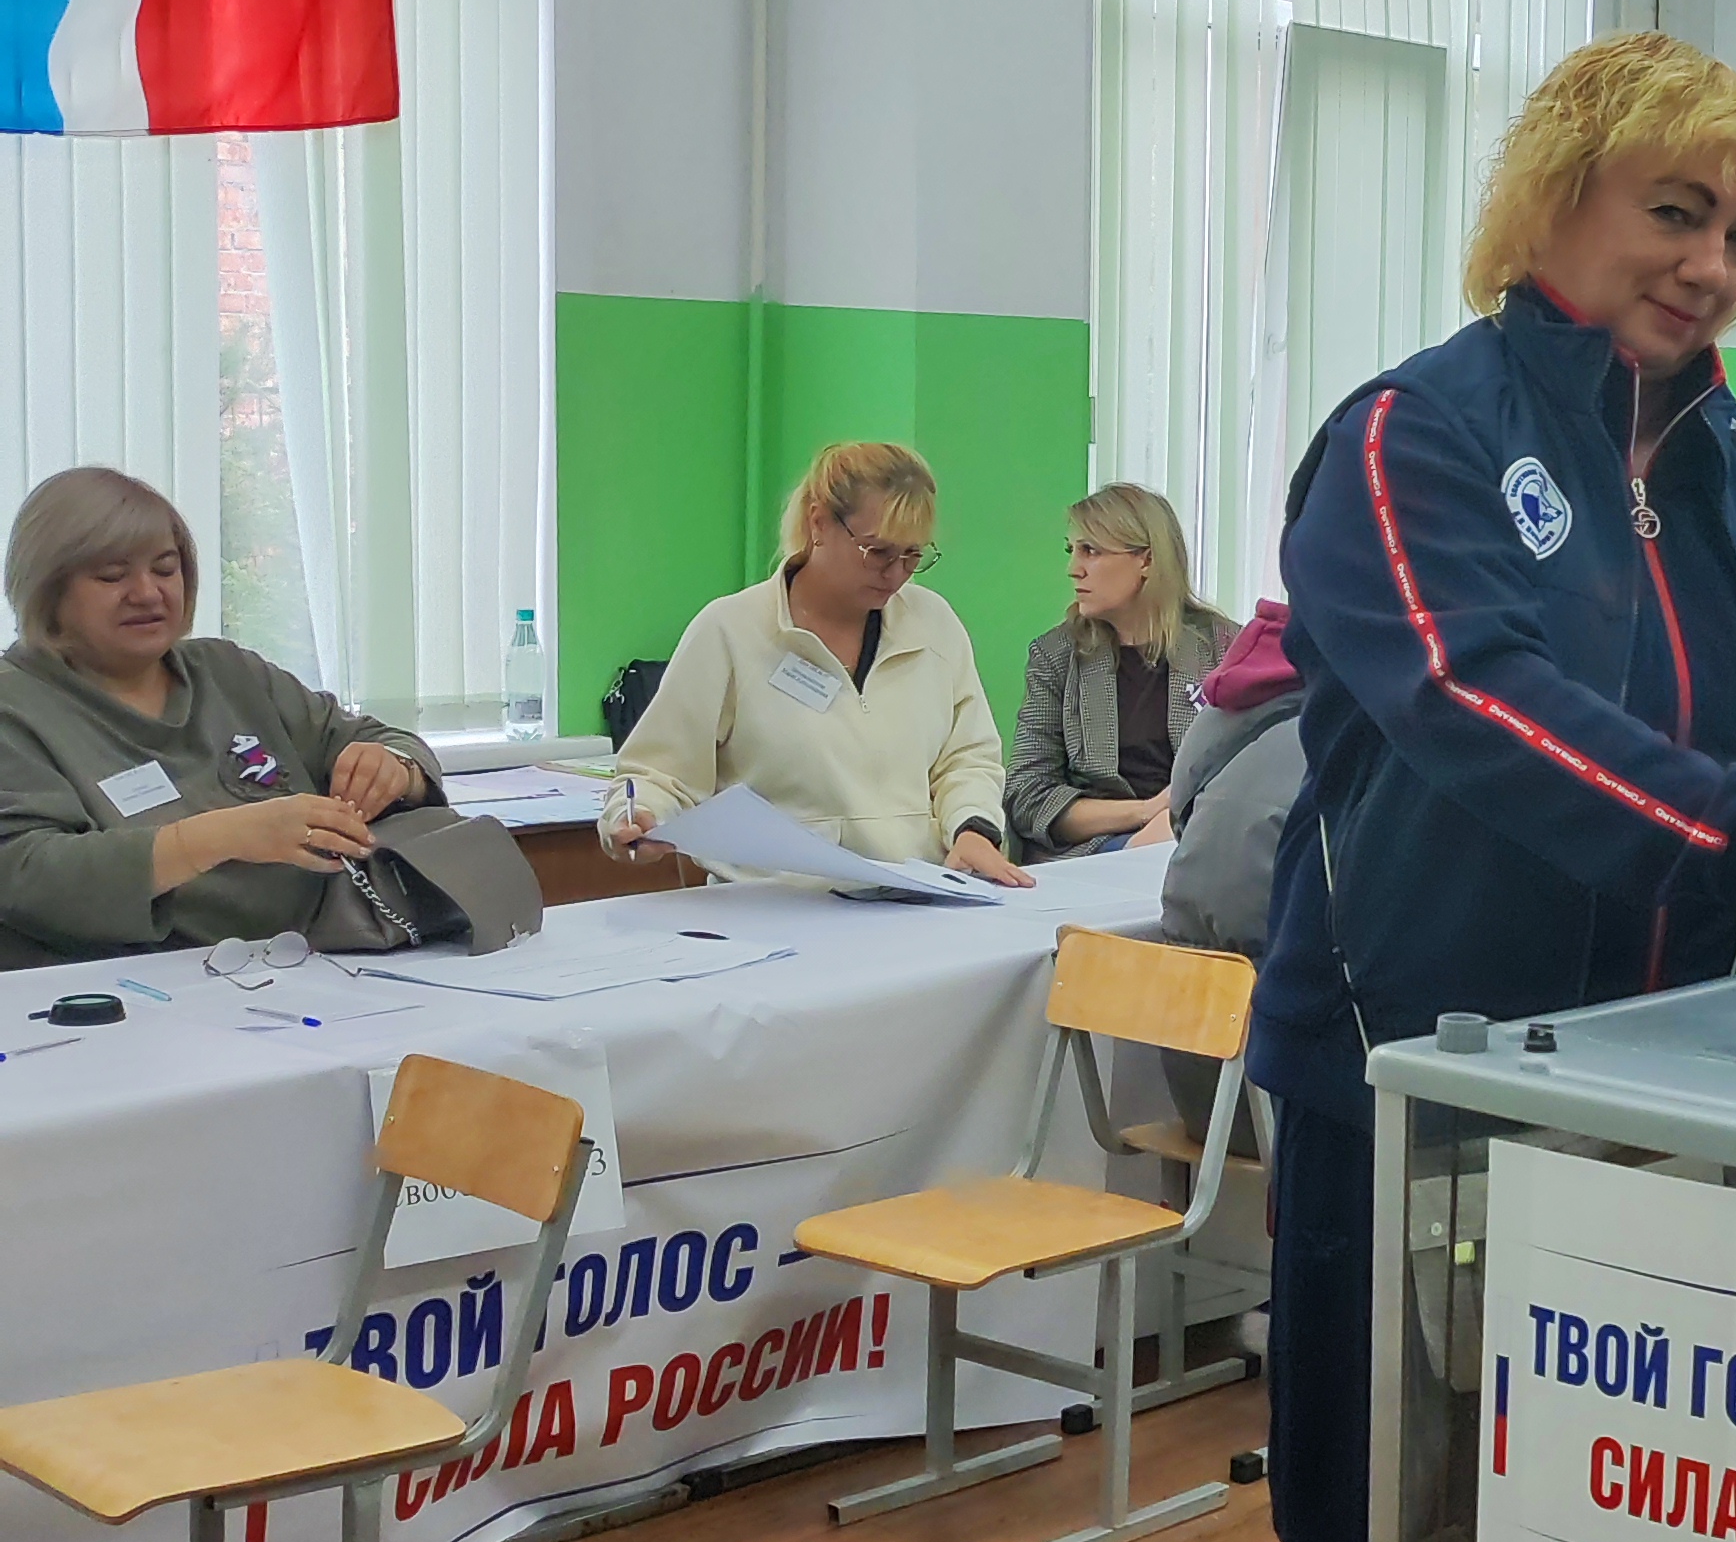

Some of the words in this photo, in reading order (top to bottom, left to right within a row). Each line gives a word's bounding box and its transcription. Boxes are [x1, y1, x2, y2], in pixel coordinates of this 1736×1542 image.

[1596, 771, 1646, 806] FORWARD
[305, 1269, 503, 1389] ВОЙ
[601, 1293, 890, 1447] РОССИИ!
[1528, 1303, 1670, 1410] ТВОЙ
